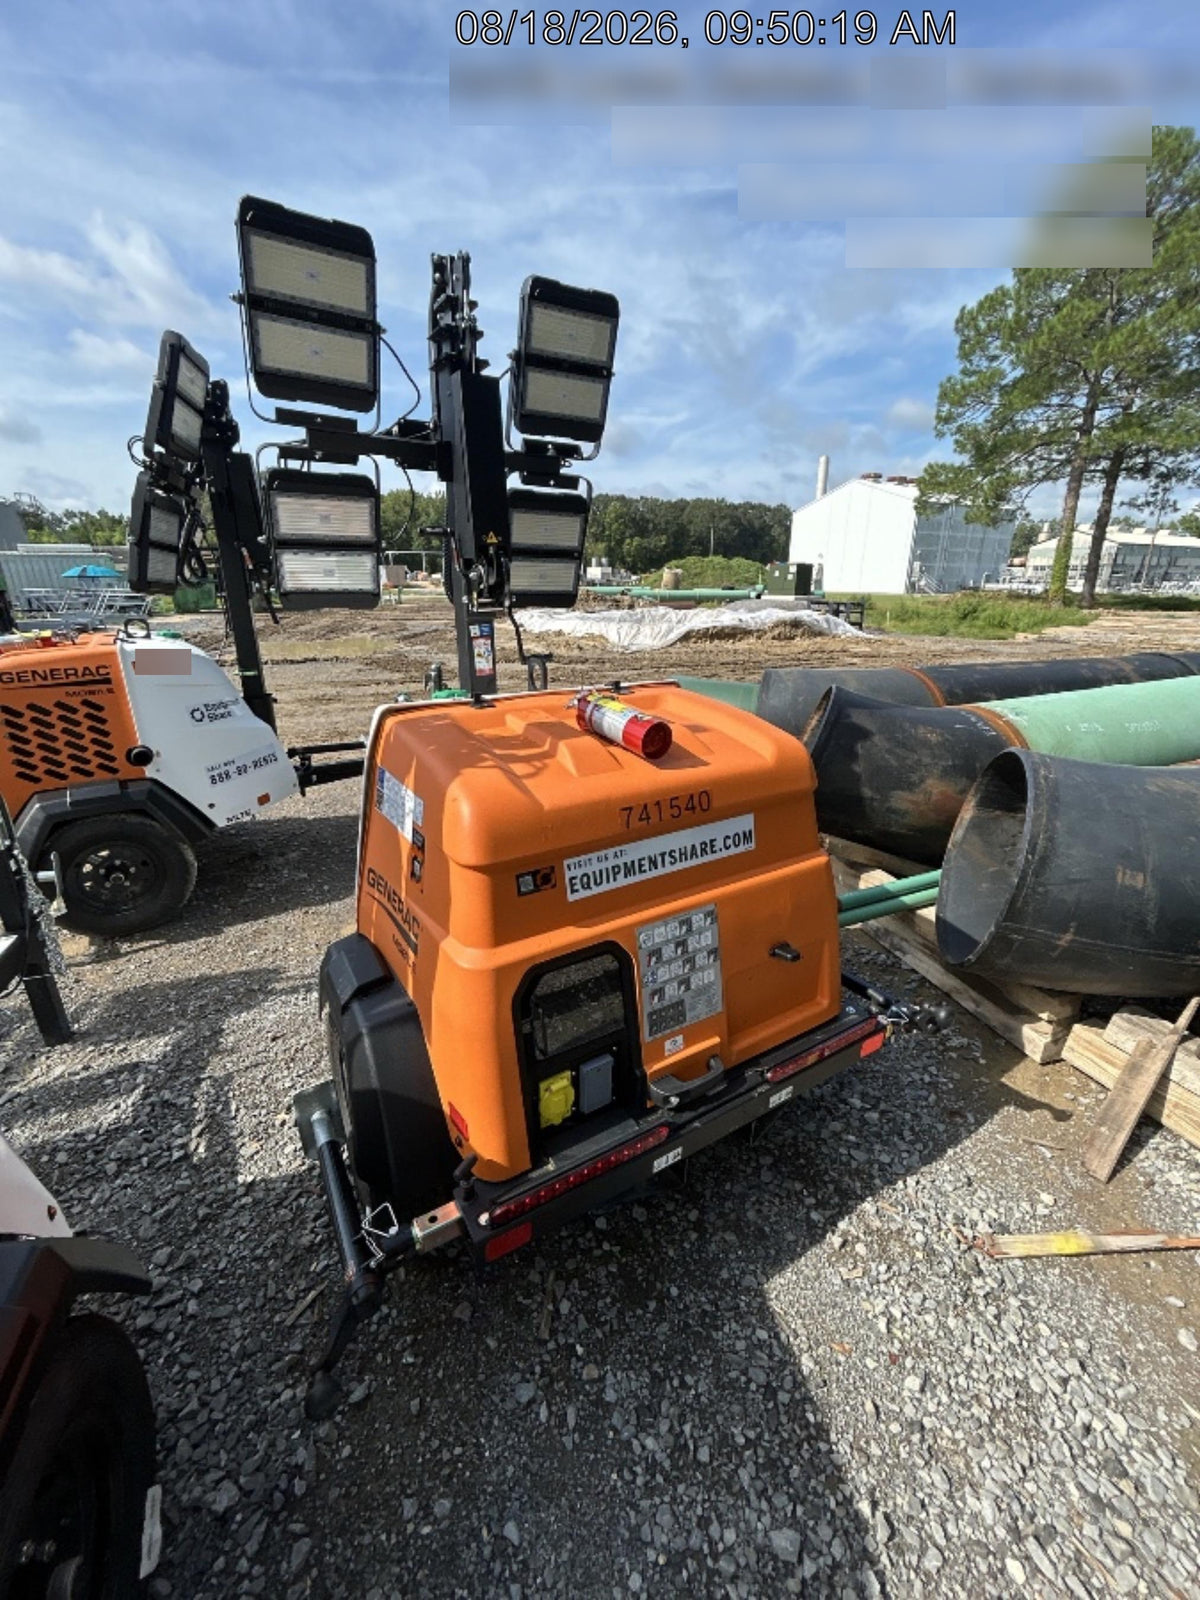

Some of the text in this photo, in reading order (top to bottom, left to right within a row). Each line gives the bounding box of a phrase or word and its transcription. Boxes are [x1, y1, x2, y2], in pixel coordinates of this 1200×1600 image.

[0, 665, 111, 684] GENERAC
[619, 789, 712, 830] 741540
[566, 857, 594, 872] VISIT
[596, 852, 610, 864] US
[568, 829, 754, 895] EQUIPMENTSHARE.COM
[367, 867, 421, 941] GENERAC
